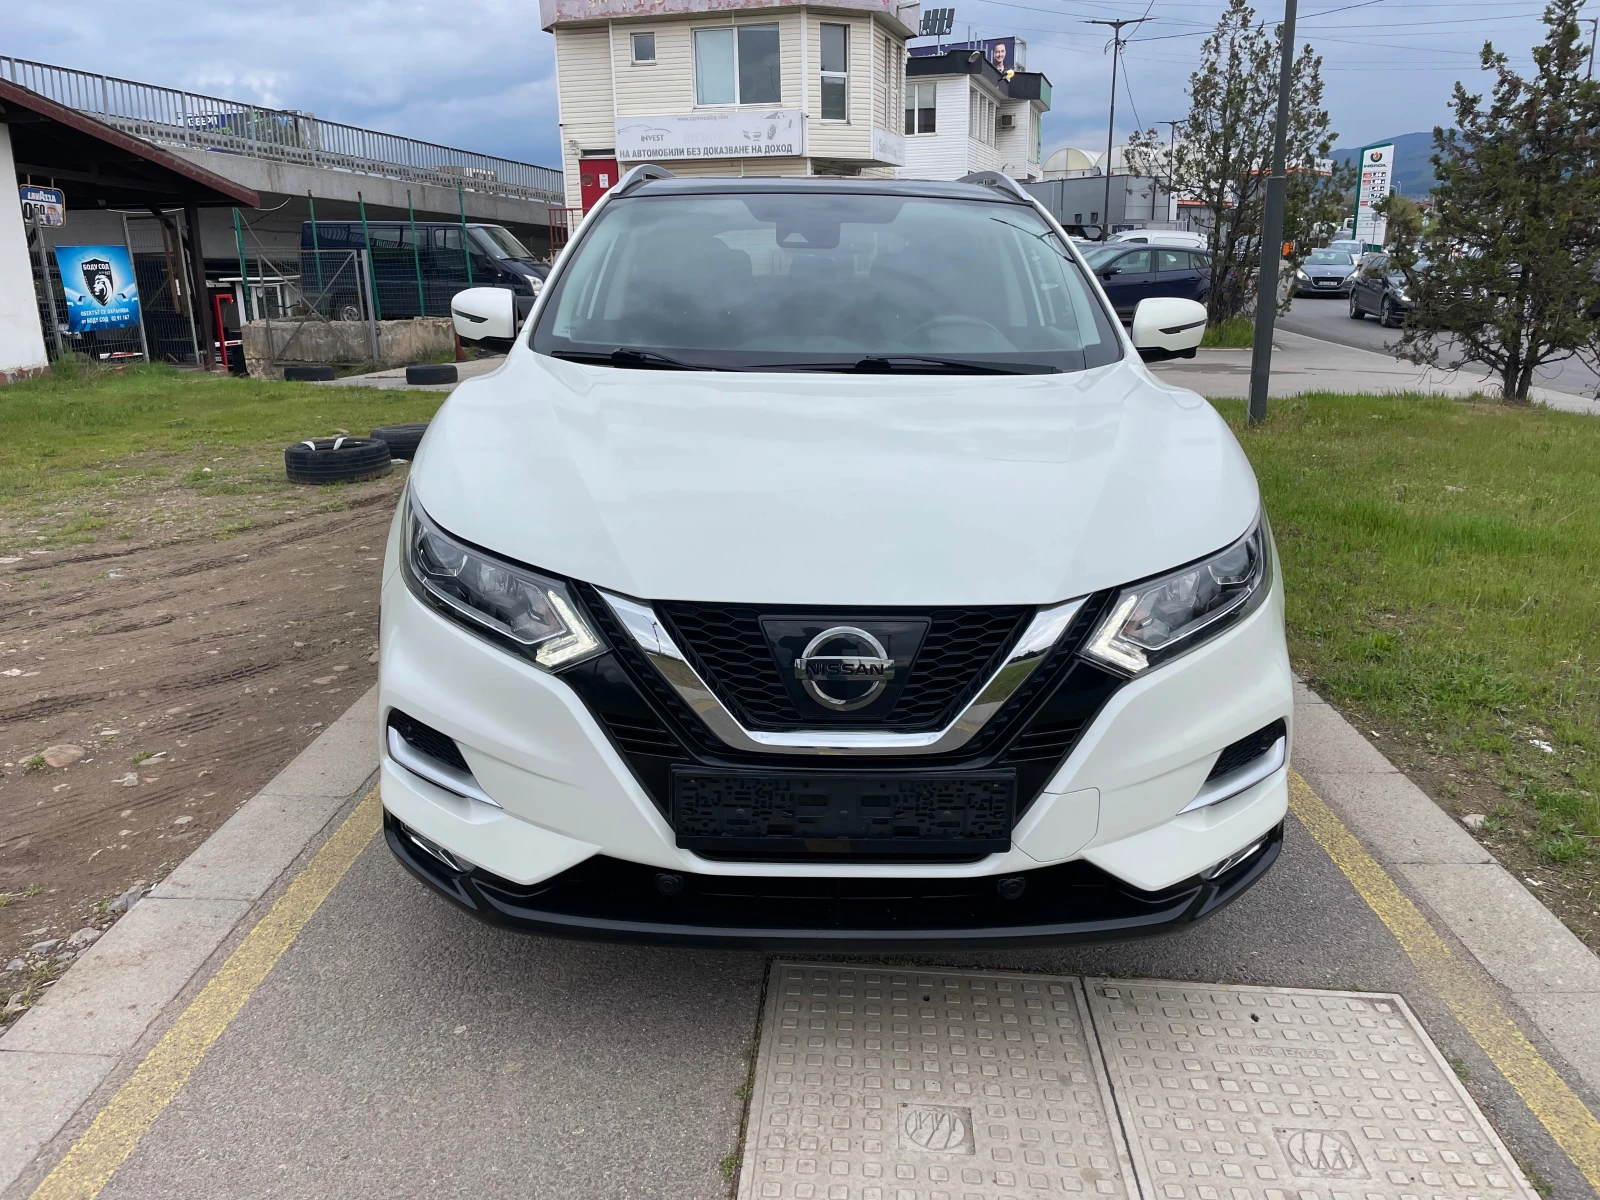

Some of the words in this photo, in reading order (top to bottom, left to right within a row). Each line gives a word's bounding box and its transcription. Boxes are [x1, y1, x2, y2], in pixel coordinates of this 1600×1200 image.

[640, 134, 664, 142] INVEST
[619, 150, 631, 158] НА
[632, 147, 685, 158] АВТОМОБИЛИ
[686, 147, 701, 156] БЕЗ
[703, 145, 750, 157] ДОКАЗВАНЕ
[751, 145, 763, 154] НА
[764, 144, 793, 155] ДОХОД
[27, 190, 57, 203] LAVAZZA
[83, 263, 98, 272] БОДУ
[98, 263, 110, 271] СОД
[805, 663, 884, 676] NISSAN
[1216, 1044, 1242, 1055] EN
